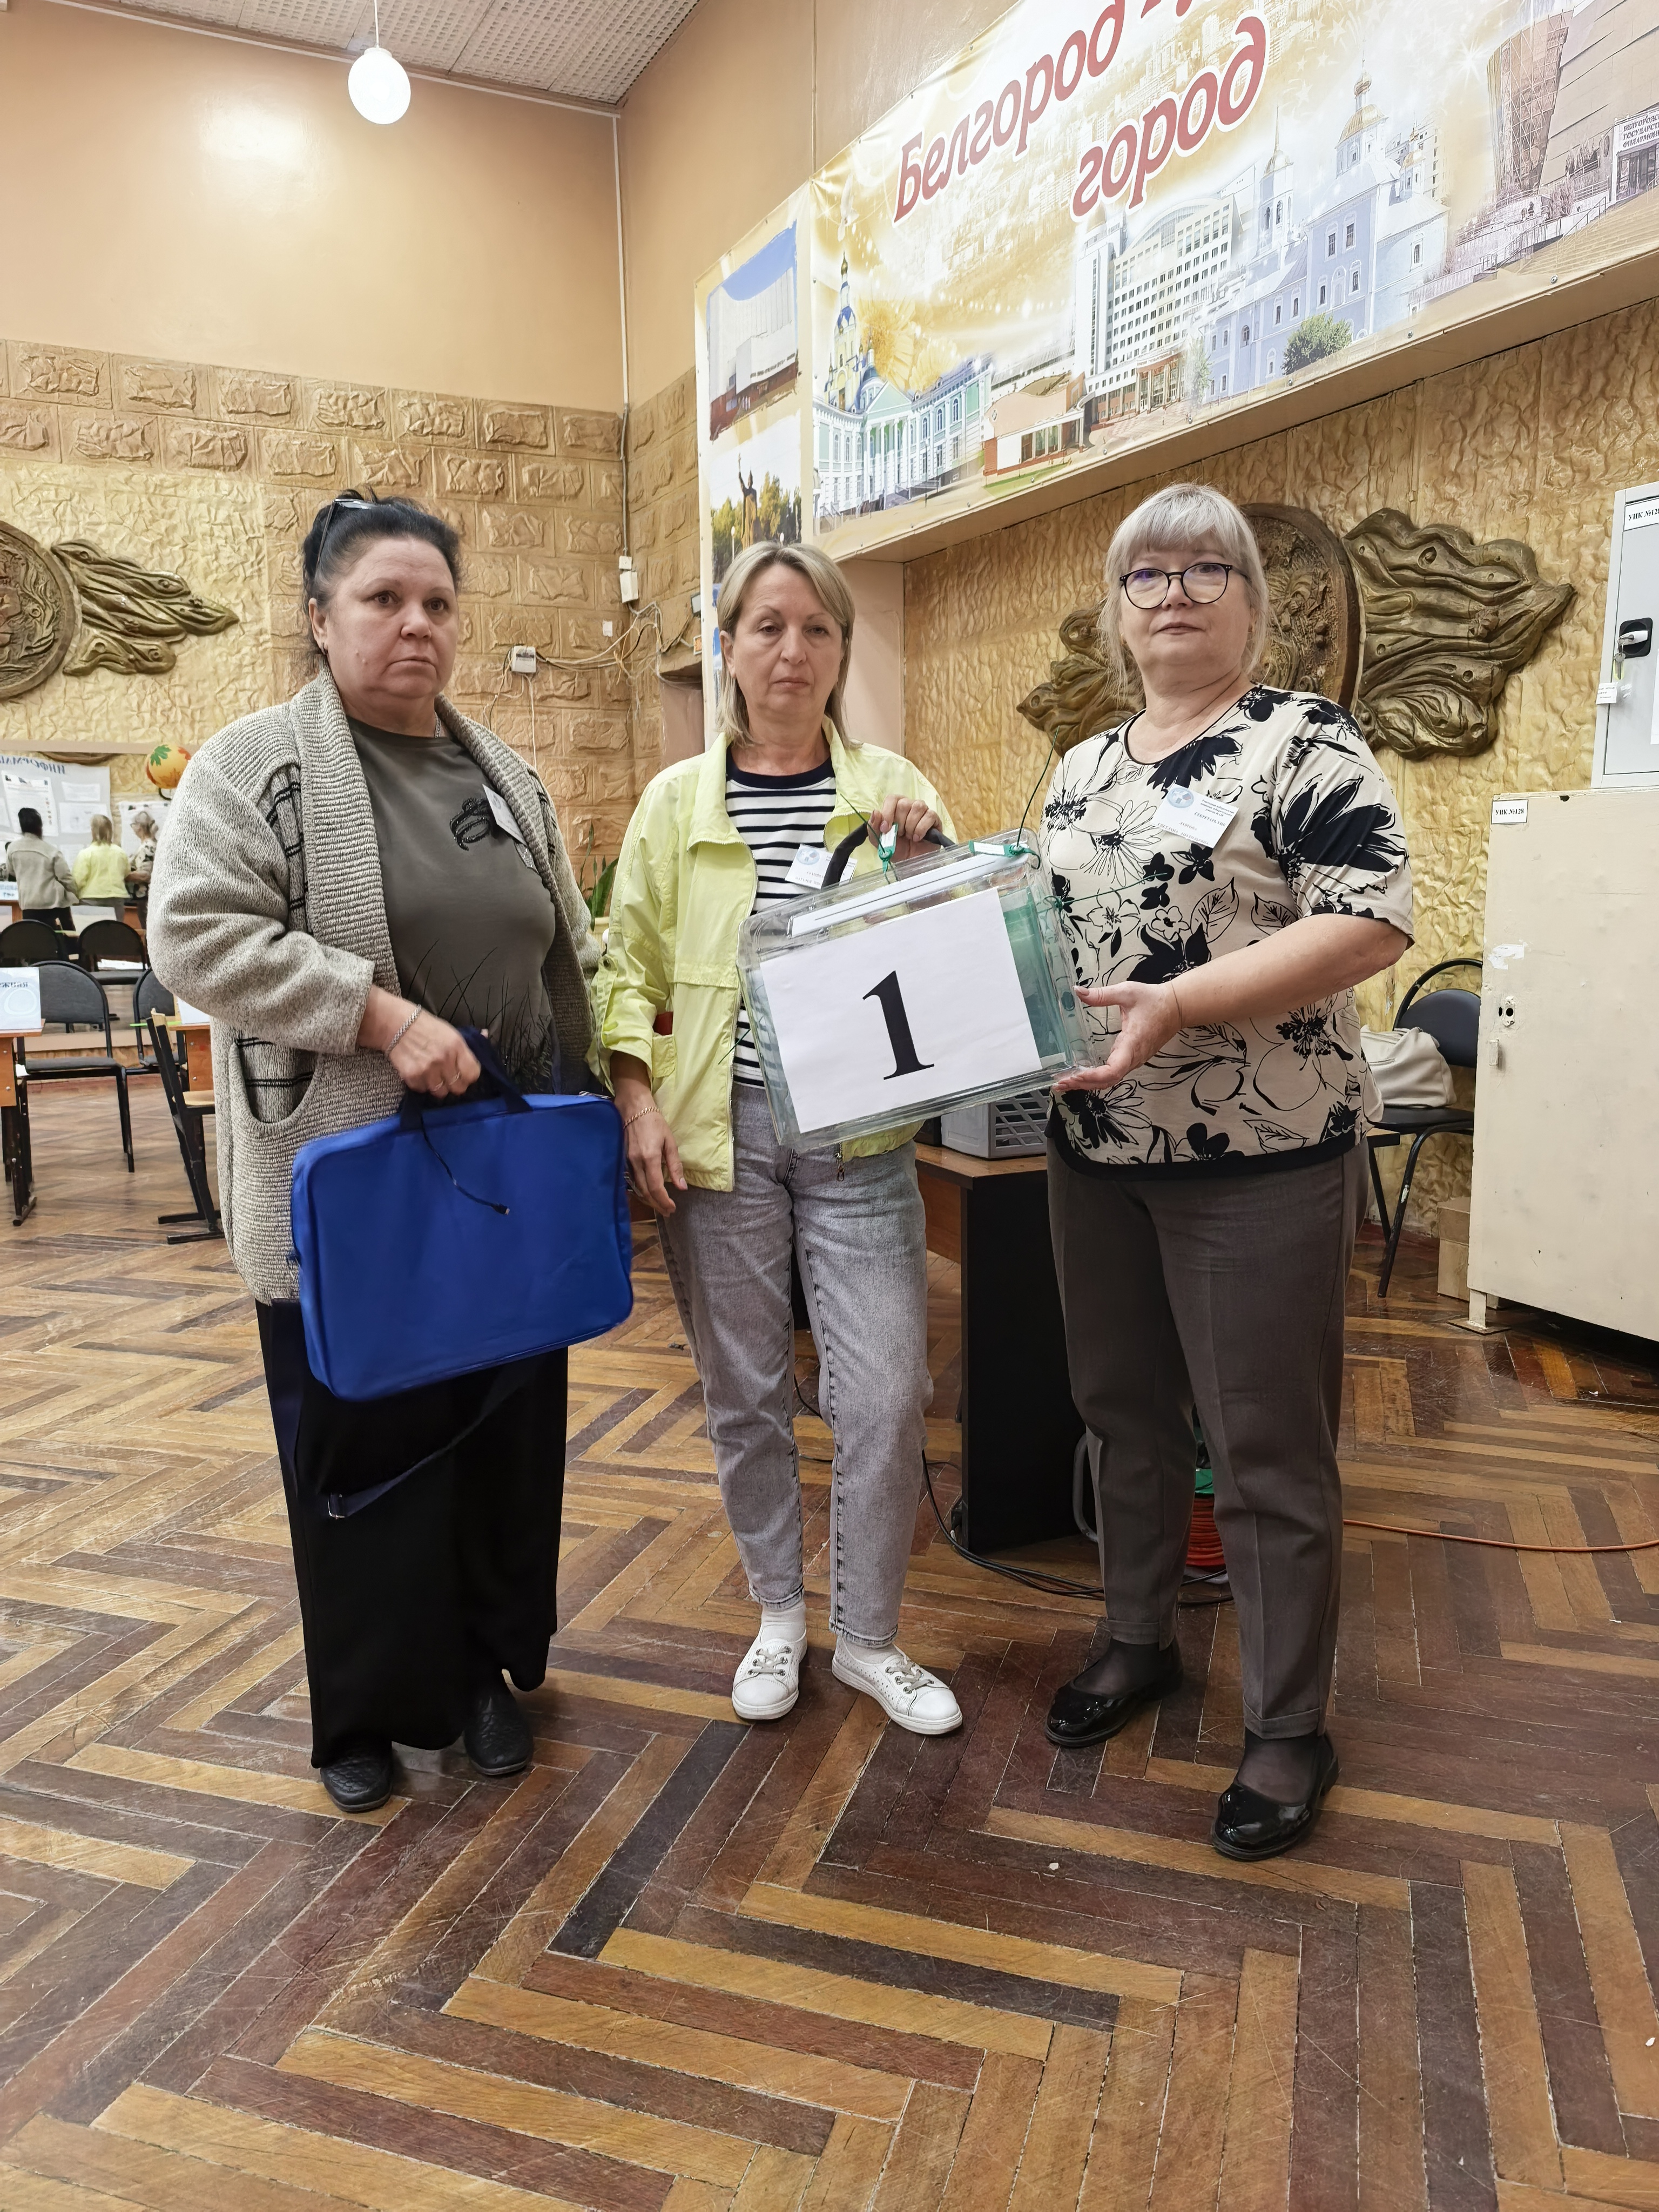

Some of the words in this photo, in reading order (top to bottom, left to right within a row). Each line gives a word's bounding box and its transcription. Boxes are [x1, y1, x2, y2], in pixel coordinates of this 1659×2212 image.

[894, 0, 1125, 222] Белгород
[1074, 16, 1267, 217] город
[1623, 114, 1659, 132] БЕЛГОРОДС
[1628, 512, 1643, 521] УИК
[862, 970, 935, 1080] 1
